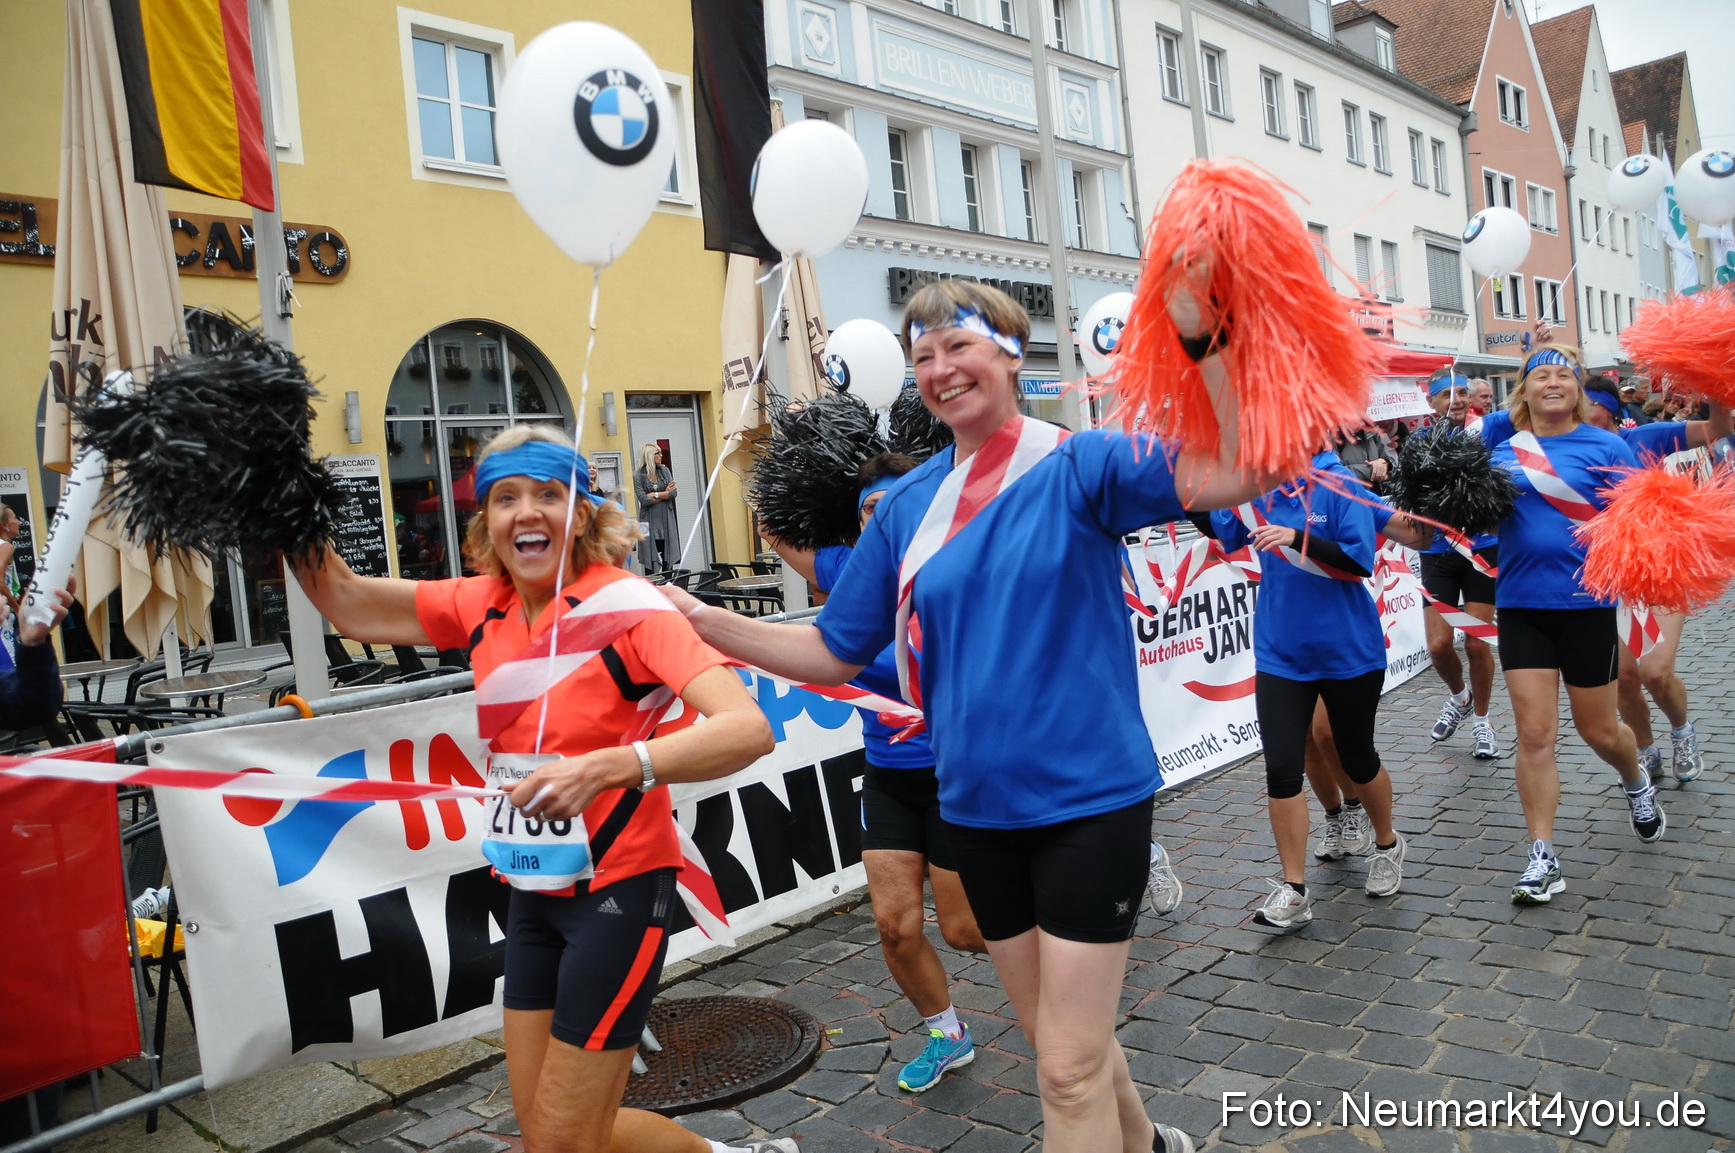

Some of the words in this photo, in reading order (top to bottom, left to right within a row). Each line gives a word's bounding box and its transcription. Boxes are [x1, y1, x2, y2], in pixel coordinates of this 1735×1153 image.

[579, 69, 654, 104] BMW
[884, 42, 966, 91] BRILLEN
[967, 66, 1037, 111] WEBER
[1384, 592, 1415, 615] MOTORS
[1140, 636, 1204, 668] Autohaus
[510, 850, 540, 870] Jina
